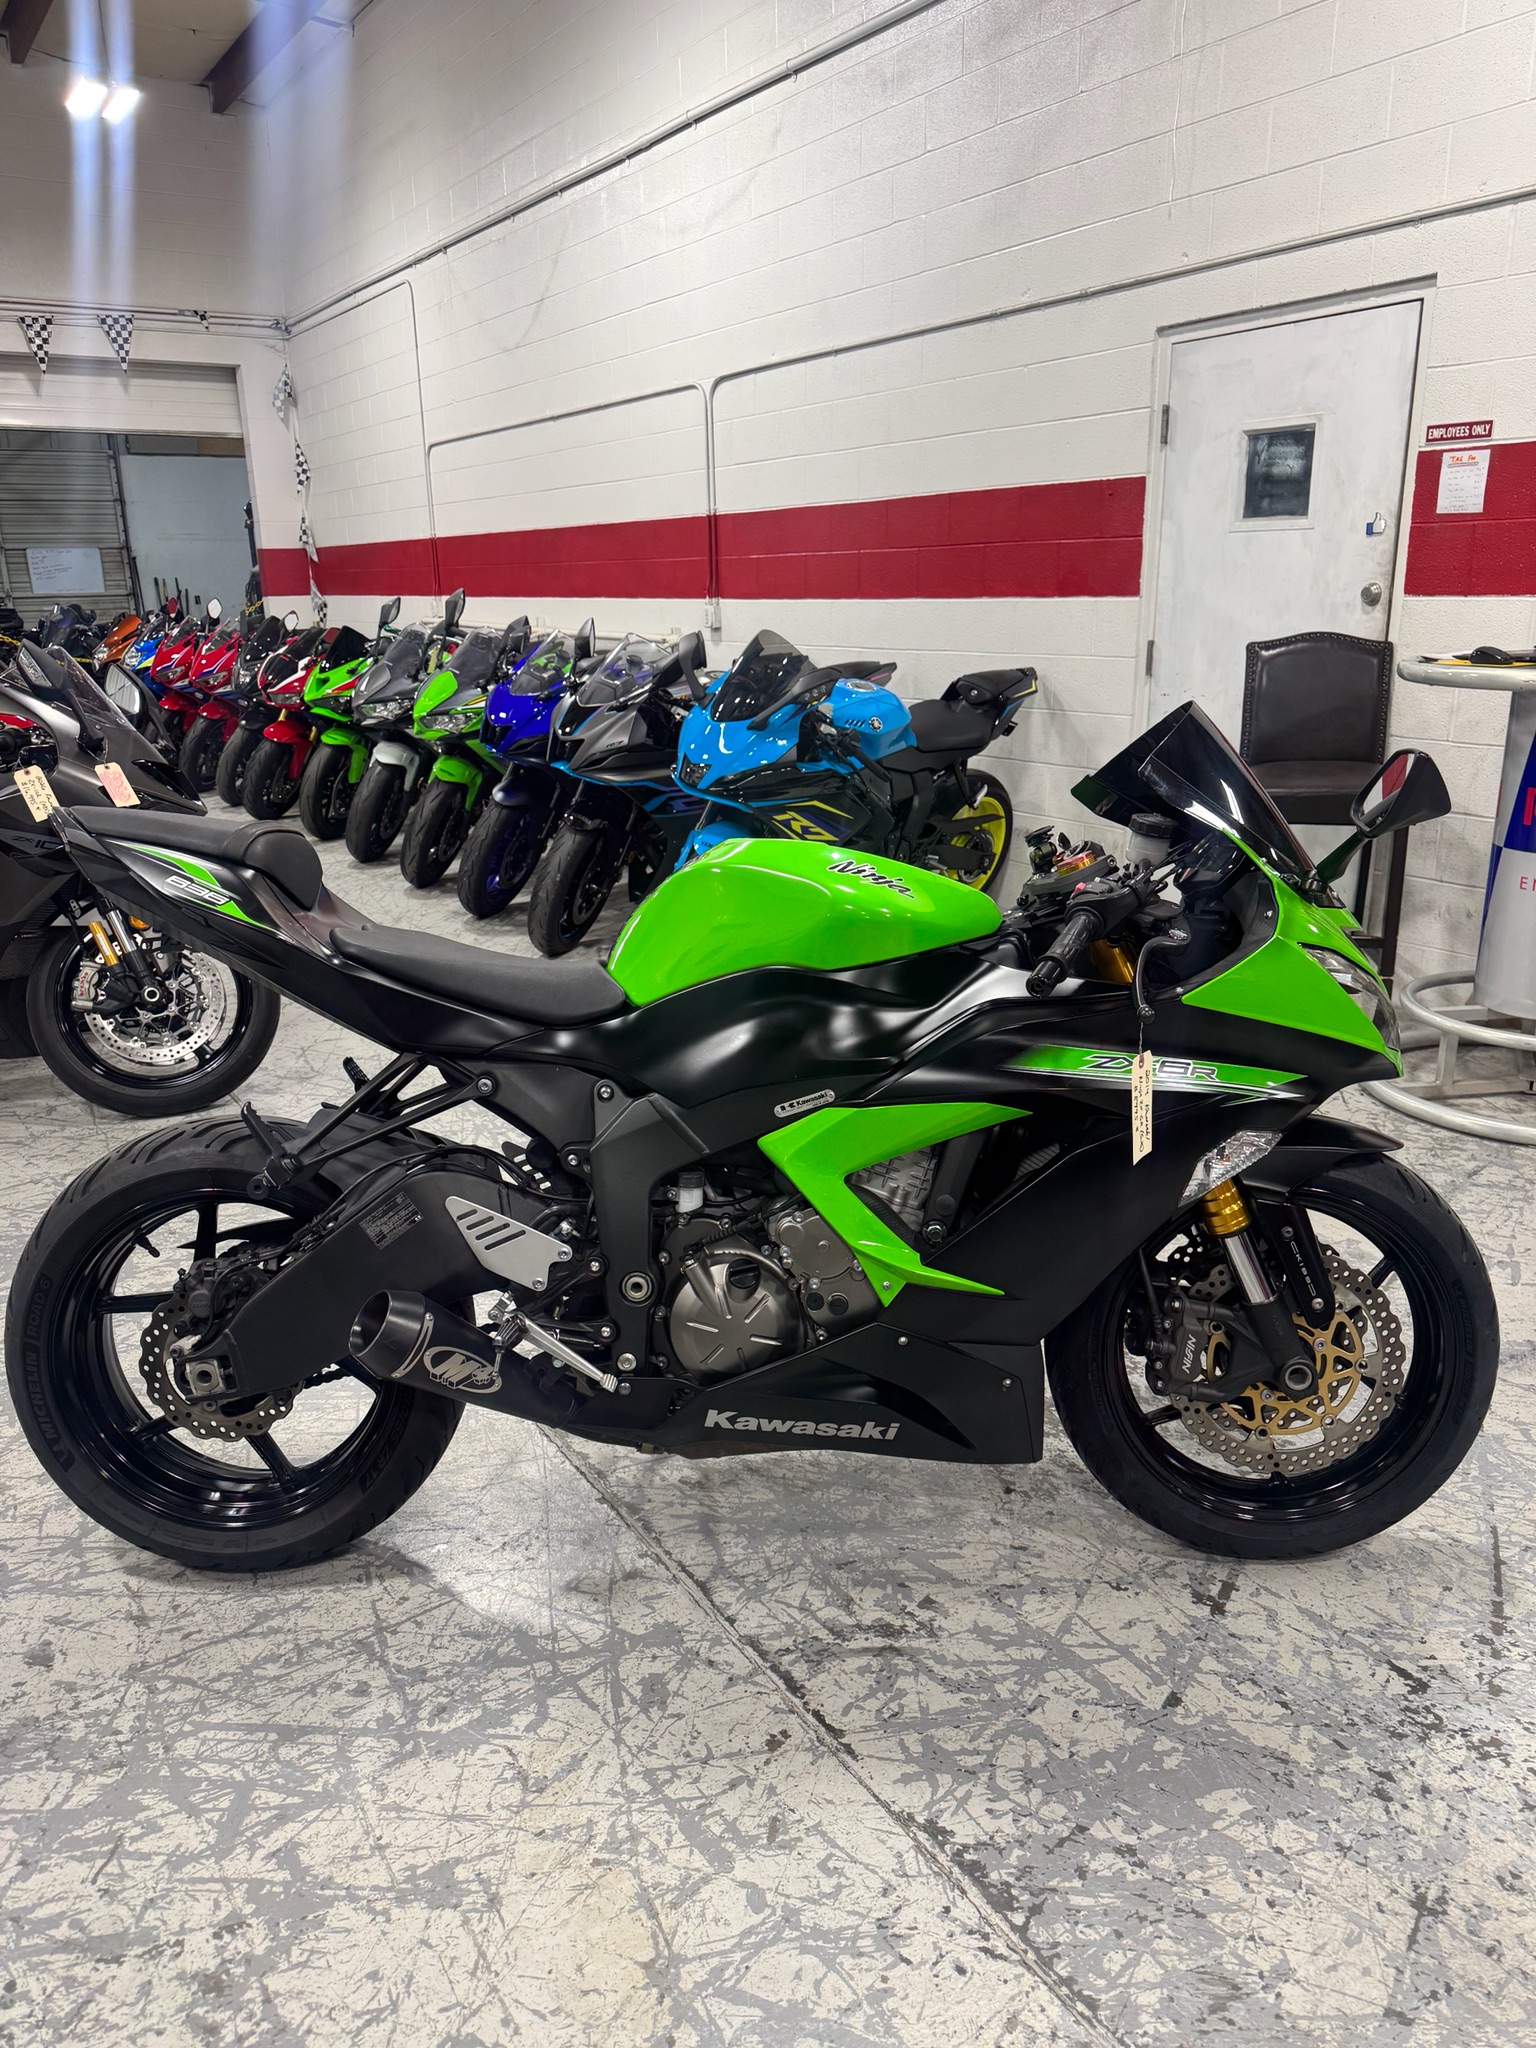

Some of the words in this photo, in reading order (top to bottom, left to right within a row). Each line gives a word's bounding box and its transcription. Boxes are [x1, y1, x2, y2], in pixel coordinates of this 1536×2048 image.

[1428, 425, 1469, 440] EMPLOYEES
[1471, 423, 1491, 436] ONLY
[164, 875, 231, 905] 636
[827, 859, 915, 899] Ninja
[79, 971, 89, 997] brembo
[1078, 1053, 1220, 1081] Z-6R
[796, 1092, 828, 1106] Kawasaki
[40, 1276, 51, 1289] 6
[26, 1293, 45, 1337] ROAD
[430, 1352, 494, 1389] M4
[25, 1351, 58, 1440] MICHELIN
[704, 1409, 900, 1440] Kawasaki
